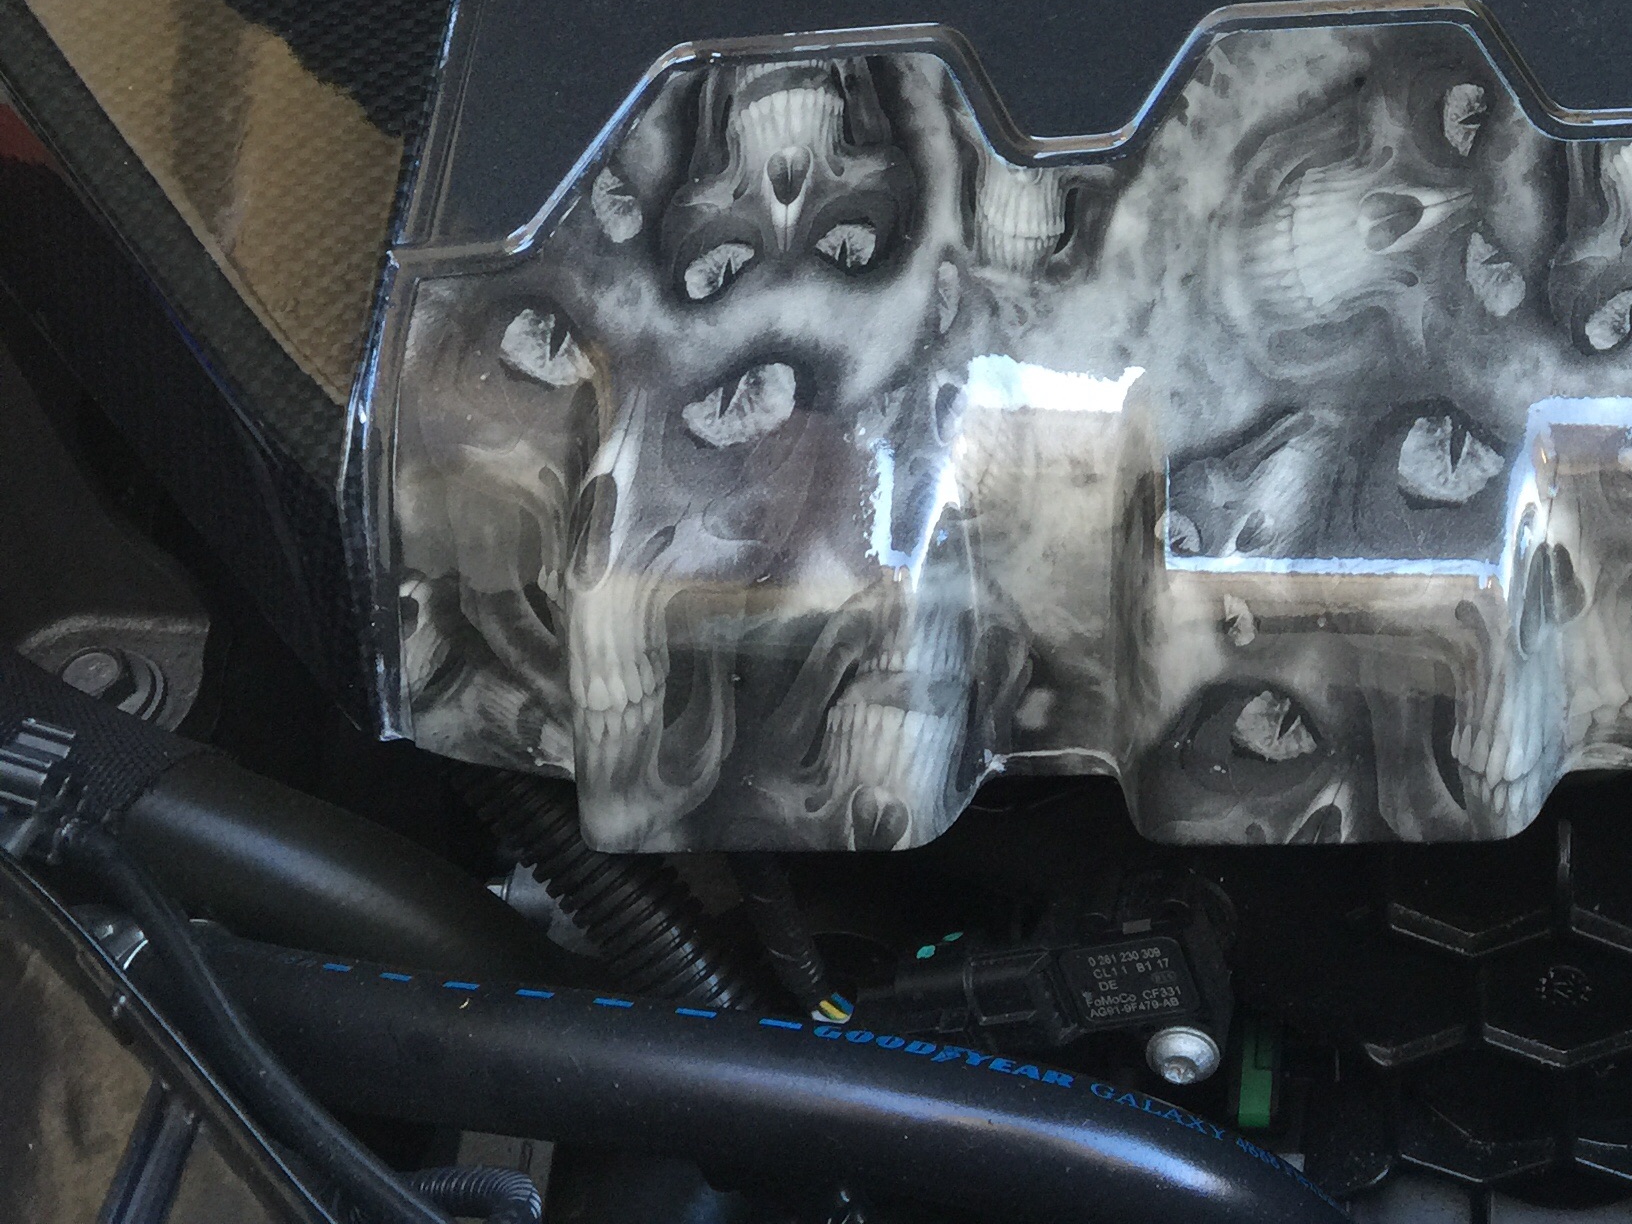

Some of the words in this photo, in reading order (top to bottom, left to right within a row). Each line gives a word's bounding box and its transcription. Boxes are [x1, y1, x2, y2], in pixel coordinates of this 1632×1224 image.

[1088, 956, 1097, 968] 0
[1120, 950, 1140, 963] 230
[1142, 946, 1162, 960] 309
[1136, 961, 1152, 973] B1
[1157, 957, 1170, 970] 17
[1098, 979, 1119, 992] DE
[1085, 992, 1137, 1008] FoMoCo
[813, 1024, 1075, 1088] GOODYEAR
[1089, 1082, 1226, 1141] GALAXY
